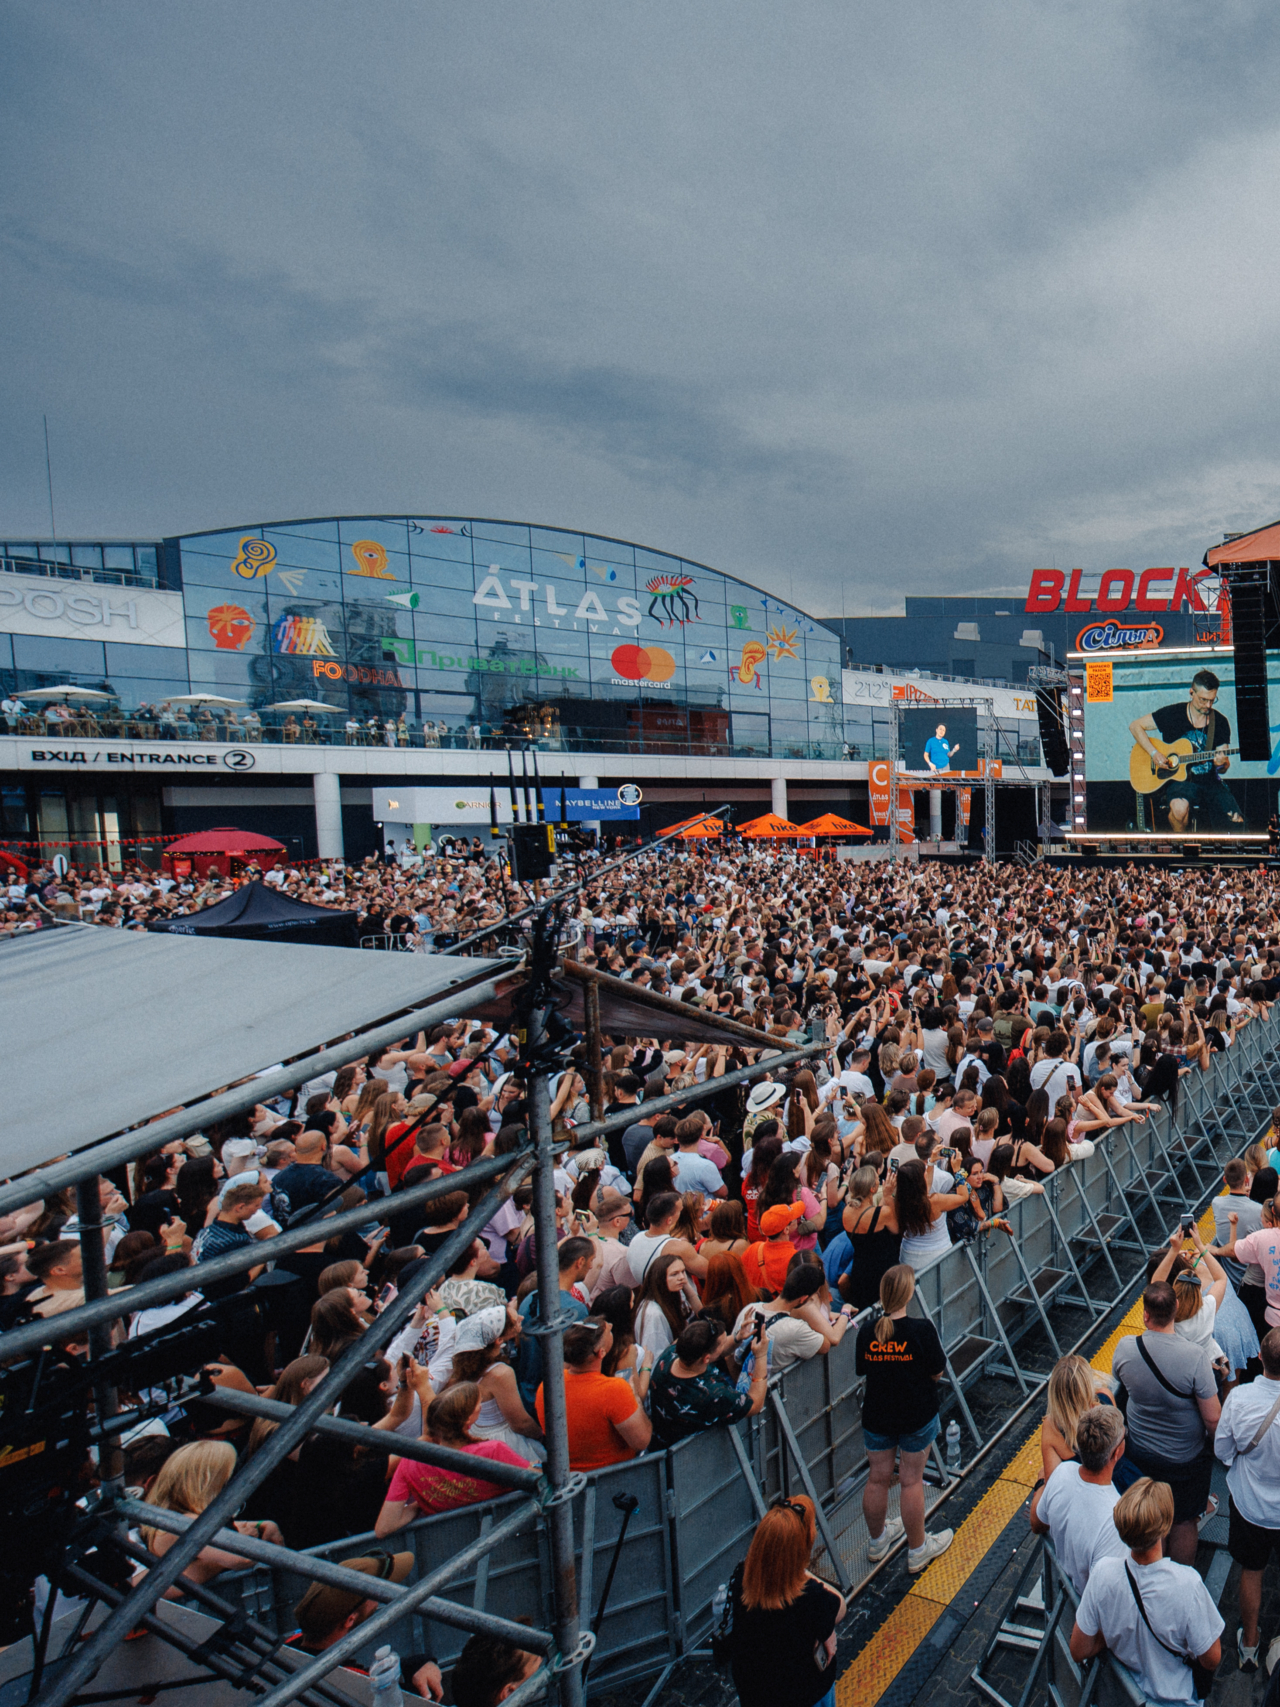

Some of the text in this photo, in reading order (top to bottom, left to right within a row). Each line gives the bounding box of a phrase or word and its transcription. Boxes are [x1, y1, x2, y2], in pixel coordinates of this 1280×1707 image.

[1024, 567, 1232, 613] BLOCK
[494, 612, 640, 638] FESTIVAL
[417, 649, 580, 679] ПриватБанк
[313, 660, 415, 689] FOODHALL
[611, 677, 671, 690] mastercard
[31, 751, 88, 763] ВХІД
[107, 752, 217, 765] ENTRANCE
[872, 764, 888, 786] C
[1268, 1246, 1276, 1255] Я
[869, 1340, 908, 1353] CREW
[884, 1354, 913, 1362] FESTIVAL
